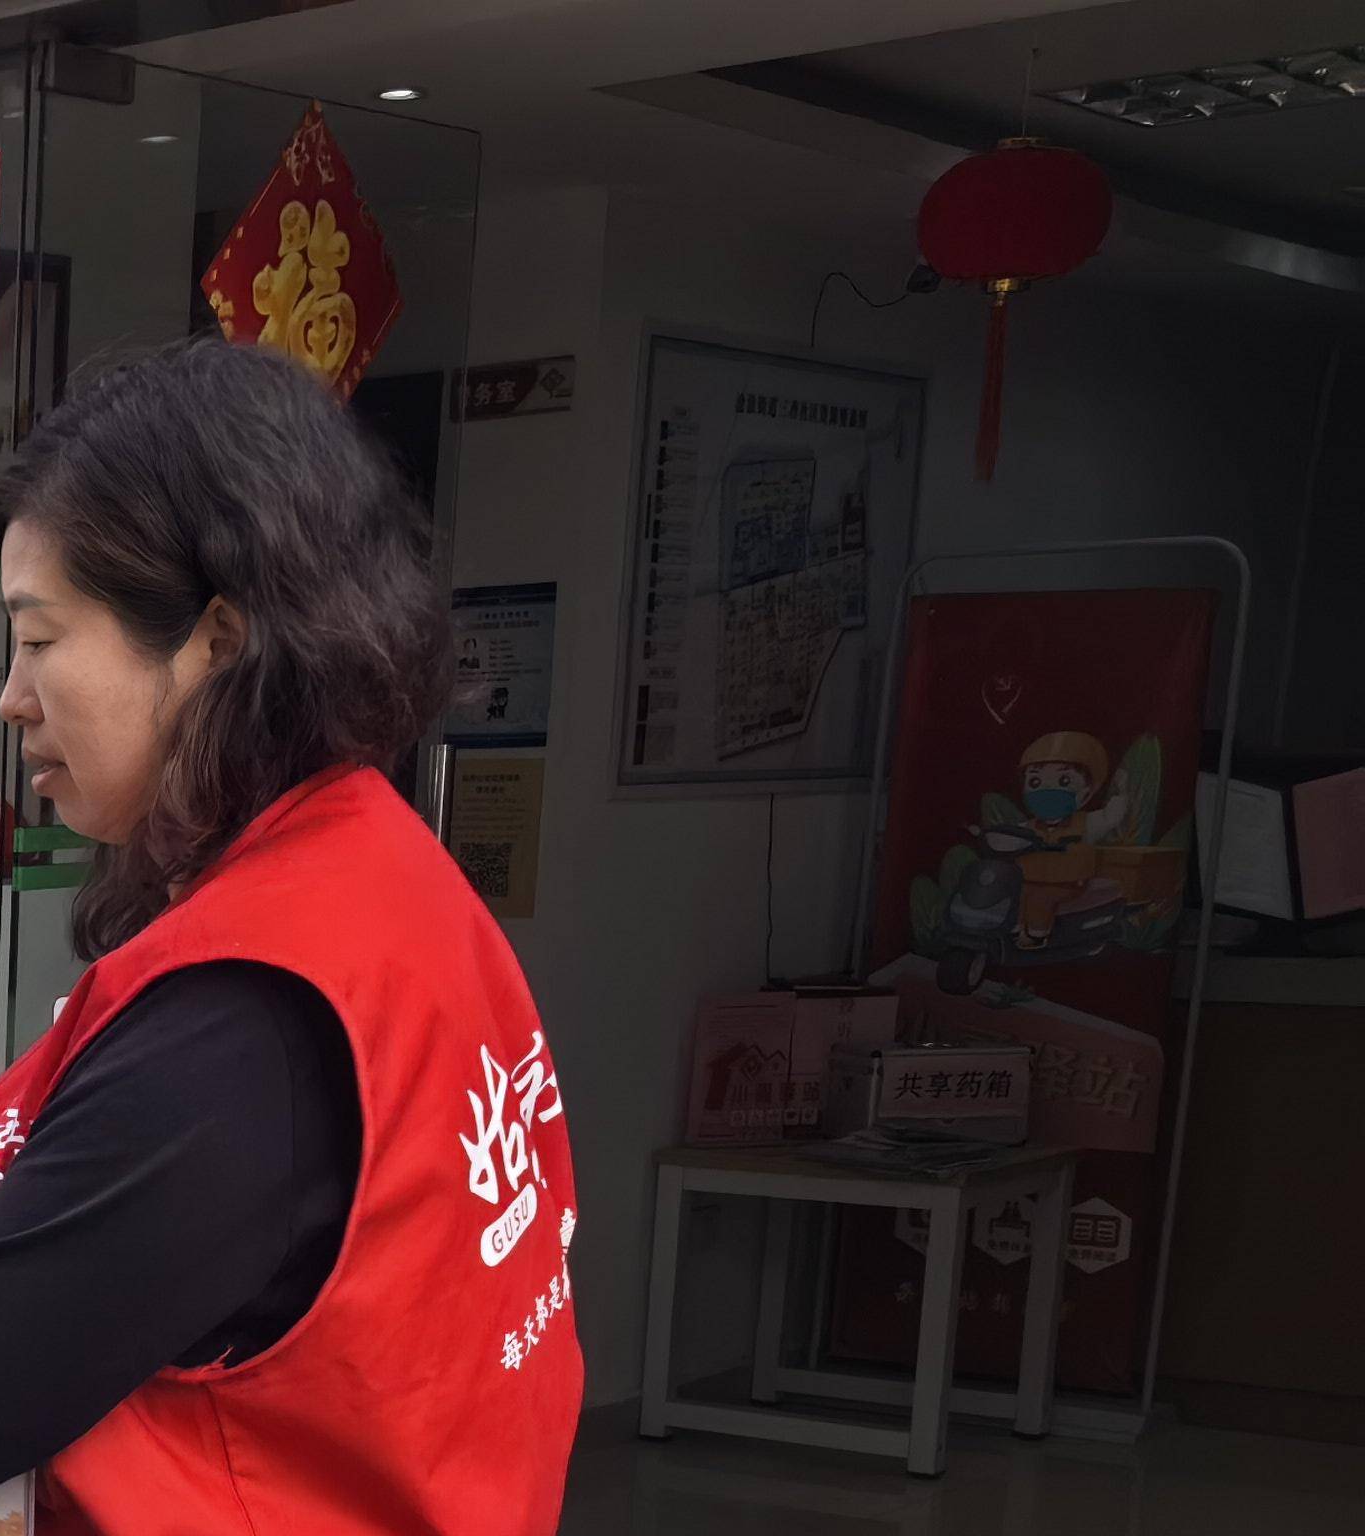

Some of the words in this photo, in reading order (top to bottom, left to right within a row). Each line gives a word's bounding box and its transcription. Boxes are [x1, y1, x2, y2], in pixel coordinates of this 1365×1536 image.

[894, 1069, 1014, 1100] 共享药箱
[491, 1196, 530, 1254] GUSU
